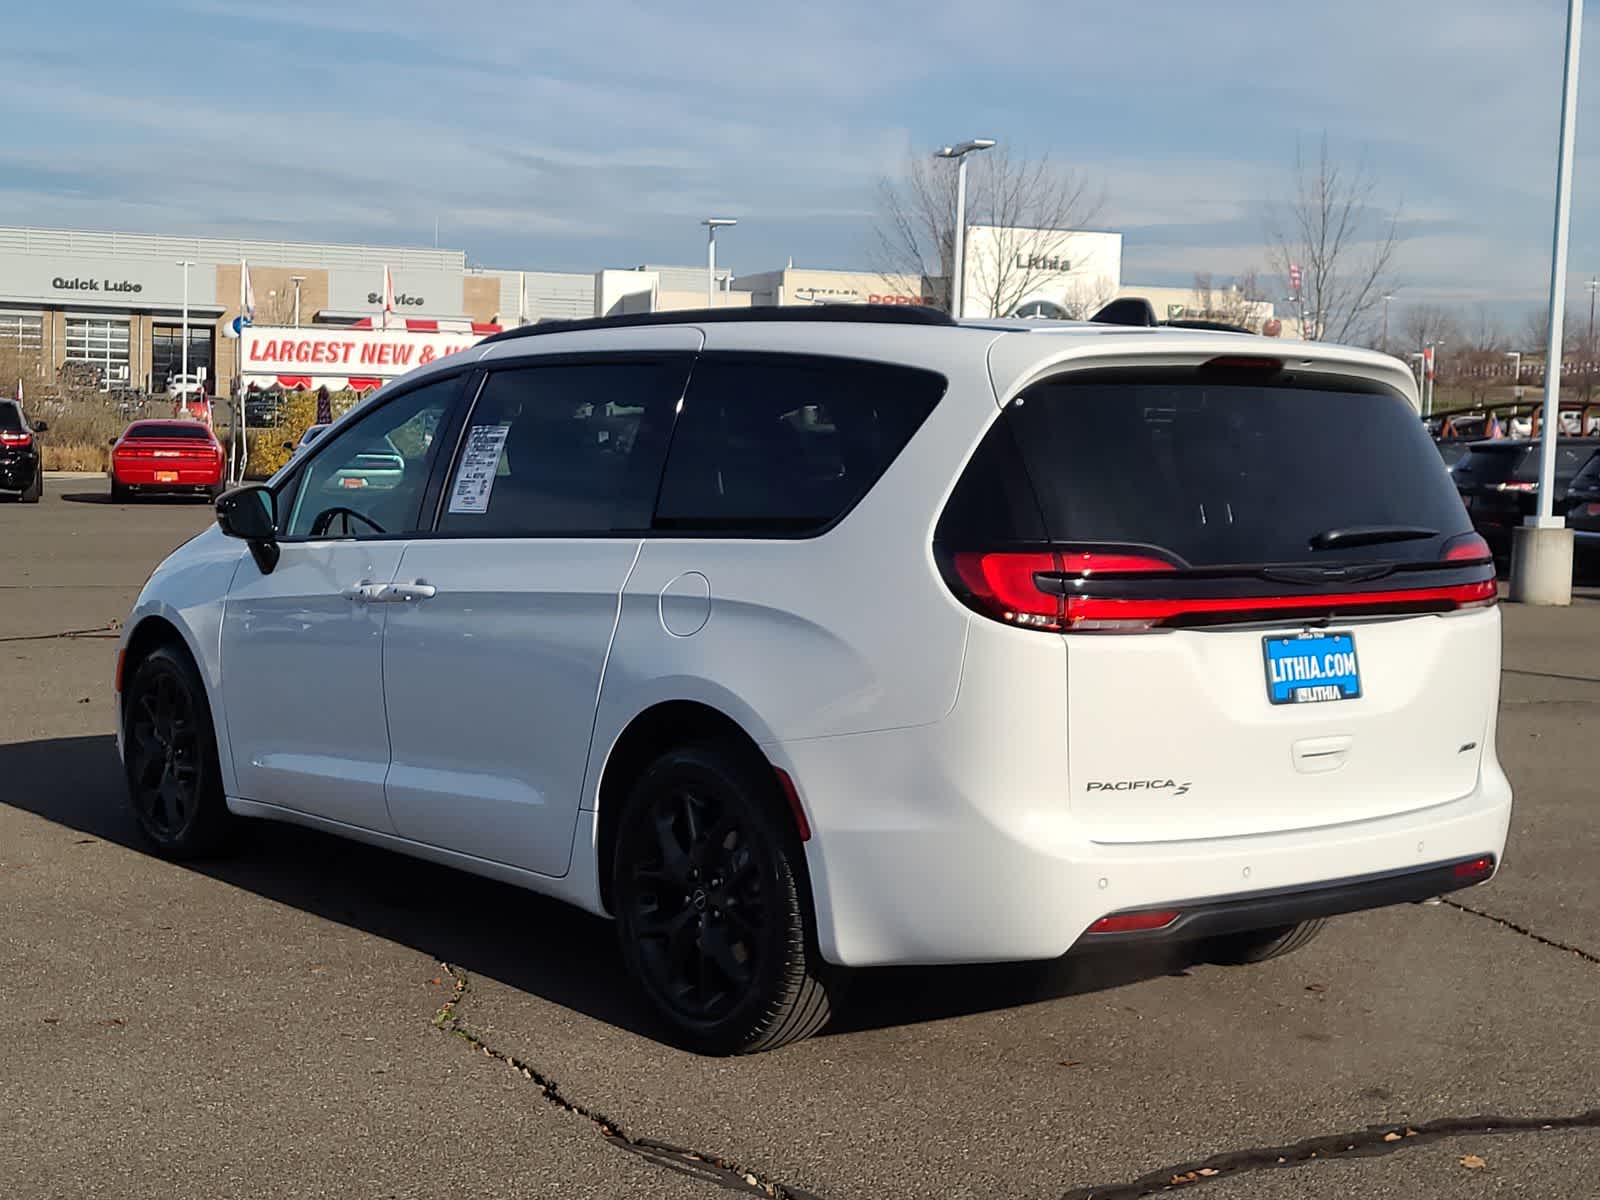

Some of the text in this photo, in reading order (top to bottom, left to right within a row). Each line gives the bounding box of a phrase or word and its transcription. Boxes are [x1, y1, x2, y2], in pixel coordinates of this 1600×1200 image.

[1016, 254, 1070, 272] Lithia
[52, 277, 142, 293] Quick Lube
[367, 292, 425, 306] Sevice
[249, 339, 355, 364] LARGEST
[360, 343, 414, 365] NEW
[418, 344, 437, 368] &
[1270, 652, 1357, 683] LITHIA.COM
[1308, 685, 1342, 701] LITHIA
[1086, 779, 1176, 792] PACIFICA
